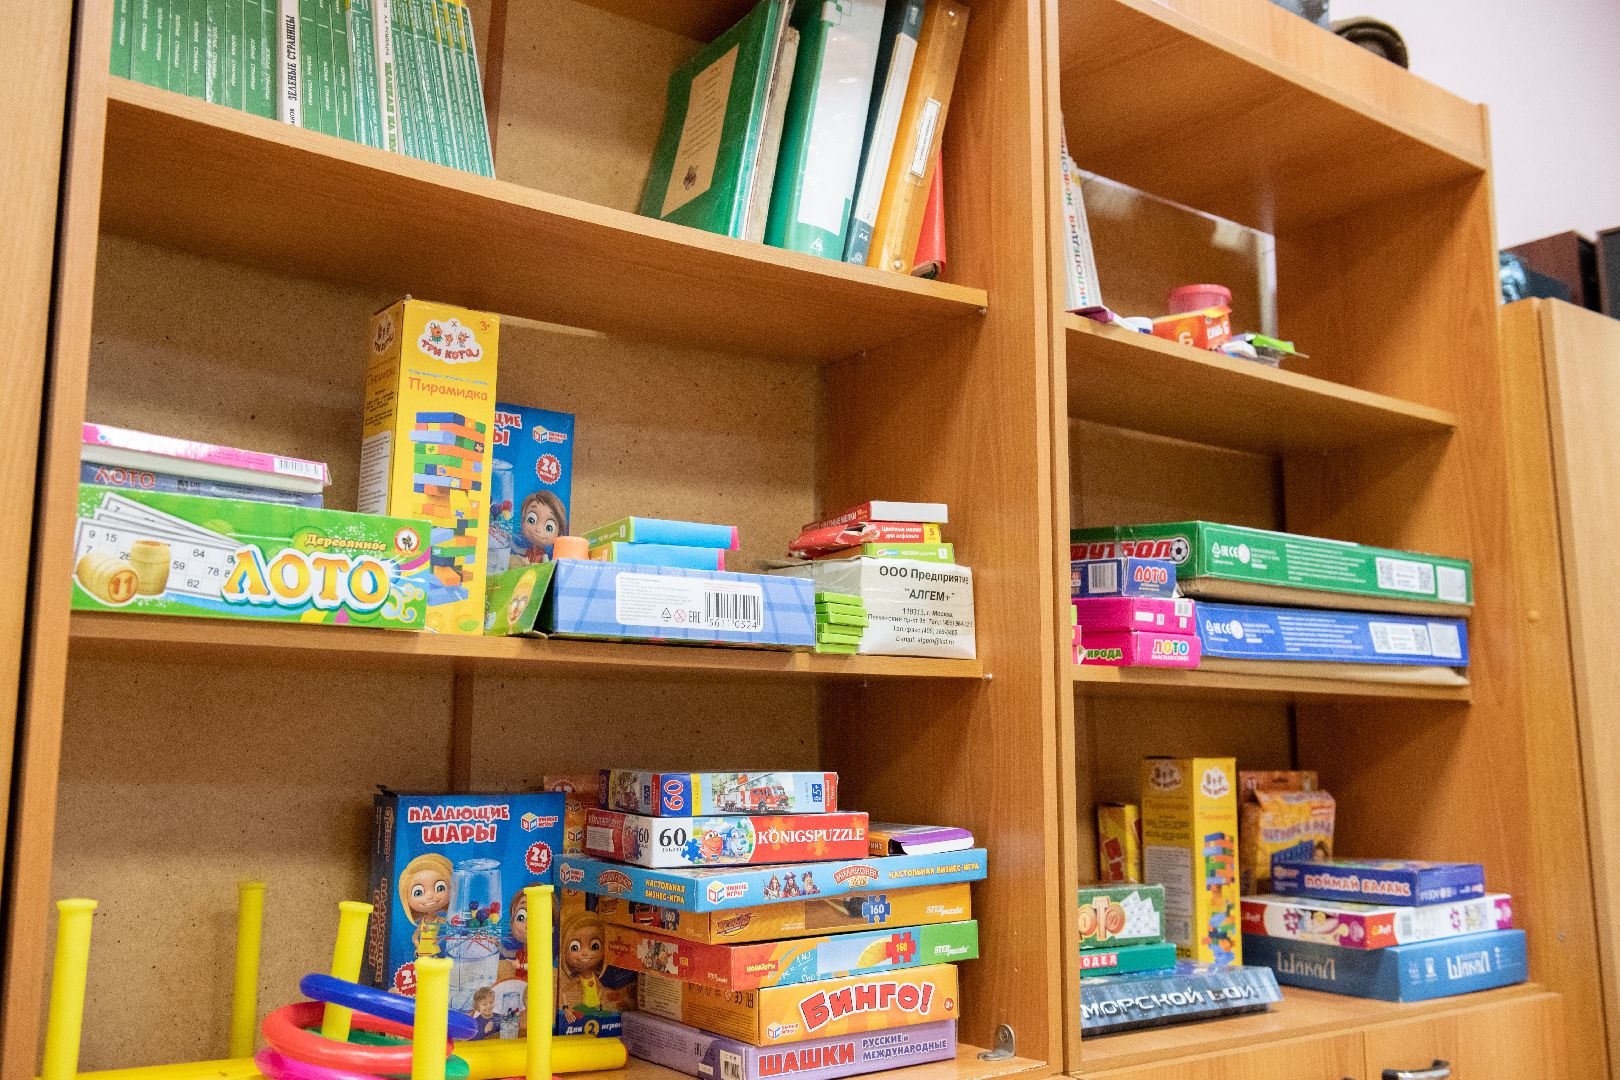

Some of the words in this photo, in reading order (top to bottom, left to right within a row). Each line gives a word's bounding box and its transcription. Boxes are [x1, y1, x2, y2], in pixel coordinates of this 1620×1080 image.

[285, 15, 297, 60] СТРАНИЦЫ
[287, 62, 297, 101] ЗЕЛЕНЫЕ
[1068, 214, 1089, 306] ИКЛОПЕДИЯ
[409, 377, 488, 400] Пирамидка
[541, 458, 557, 475] 24
[95, 466, 156, 489] ЛОТО
[88, 530, 96, 539] 9
[105, 533, 117, 543] 15
[928, 528, 935, 536] 5
[304, 533, 387, 551] Деревянное
[193, 549, 205, 558] 64
[172, 561, 185, 571] 59
[207, 567, 219, 577] 78
[223, 548, 391, 605] ЛОТО
[879, 565, 908, 578] ООО
[911, 568, 969, 585] Предприятие
[1134, 566, 1168, 583] ЛОТО
[187, 579, 200, 588] 62
[904, 588, 955, 602] "АЛГЕМ+"
[689, 611, 701, 624] EAC
[1086, 649, 1122, 660] ИРОДА
[1153, 640, 1188, 654] ЛОТО
[663, 779, 684, 811] 60
[408, 805, 510, 823] ПАДАЮЩИЕ
[422, 824, 498, 844] ШАРЫ
[639, 828, 649, 843] 60
[659, 827, 687, 847] 60
[758, 825, 865, 846] KÖNIGSPUZZLE
[531, 847, 548, 862] 24
[888, 867, 935, 879] НАСТОЛЬНАЯ
[936, 863, 980, 875] БИЗНЕС-ИГРА
[645, 879, 686, 894] НАСТОЛЬНАЯ
[725, 882, 748, 891] УМНЫЕ
[726, 888, 744, 897] ИГРЫ
[1304, 873, 1360, 892] ПОЙМАЙ
[1361, 879, 1412, 897] БАЛАНС
[645, 889, 685, 905] БИЗНЕС-ИГРА
[869, 904, 885, 914] 160
[895, 943, 908, 952] 160
[679, 956, 689, 966] 160
[1083, 954, 1117, 967] ОДЕЛ
[800, 983, 933, 1030] БИНГО!
[945, 1000, 953, 1009] 3+
[1080, 986, 1204, 1019] МОРСКОЙ
[1206, 982, 1256, 1002] БОЙ
[566, 1026, 583, 1035] Для
[862, 1034, 902, 1047] РУССКИЕ
[863, 1039, 947, 1061] МЕЖДУНАРОДНЫЕ
[758, 1042, 855, 1077] ШАШКИ
